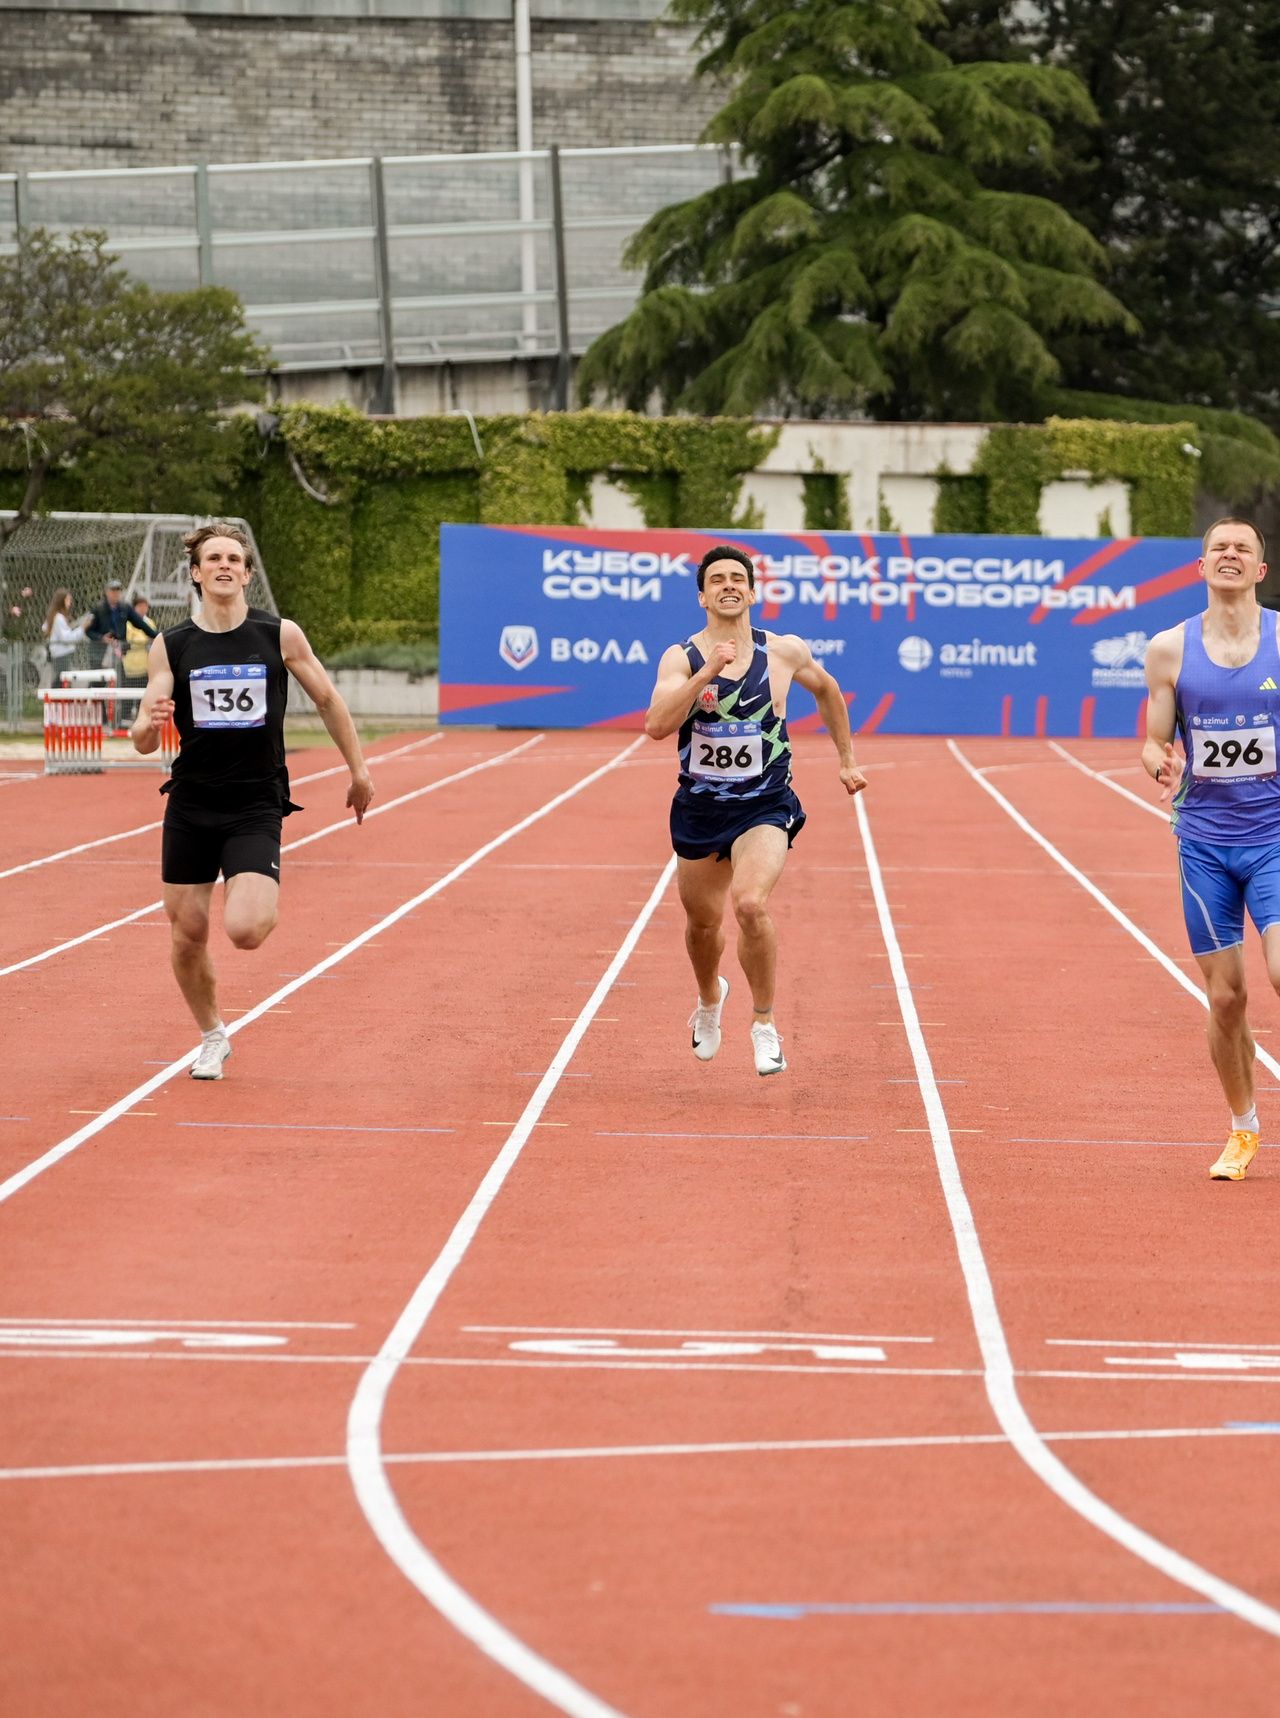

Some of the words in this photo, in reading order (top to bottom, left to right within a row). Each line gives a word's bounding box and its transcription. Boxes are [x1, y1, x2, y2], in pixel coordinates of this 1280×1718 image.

[543, 549, 691, 577] КУБОК
[887, 556, 1065, 583] РОССИИ
[542, 575, 662, 602] СОЧИ
[801, 581, 1136, 610] МНОГОБОРЬЯМ
[551, 637, 649, 664] ВФЛА
[940, 637, 1038, 667] azimut
[203, 687, 254, 712] 136
[1203, 717, 1229, 725] azimut
[699, 743, 753, 769] 286
[1203, 738, 1264, 768] 296
